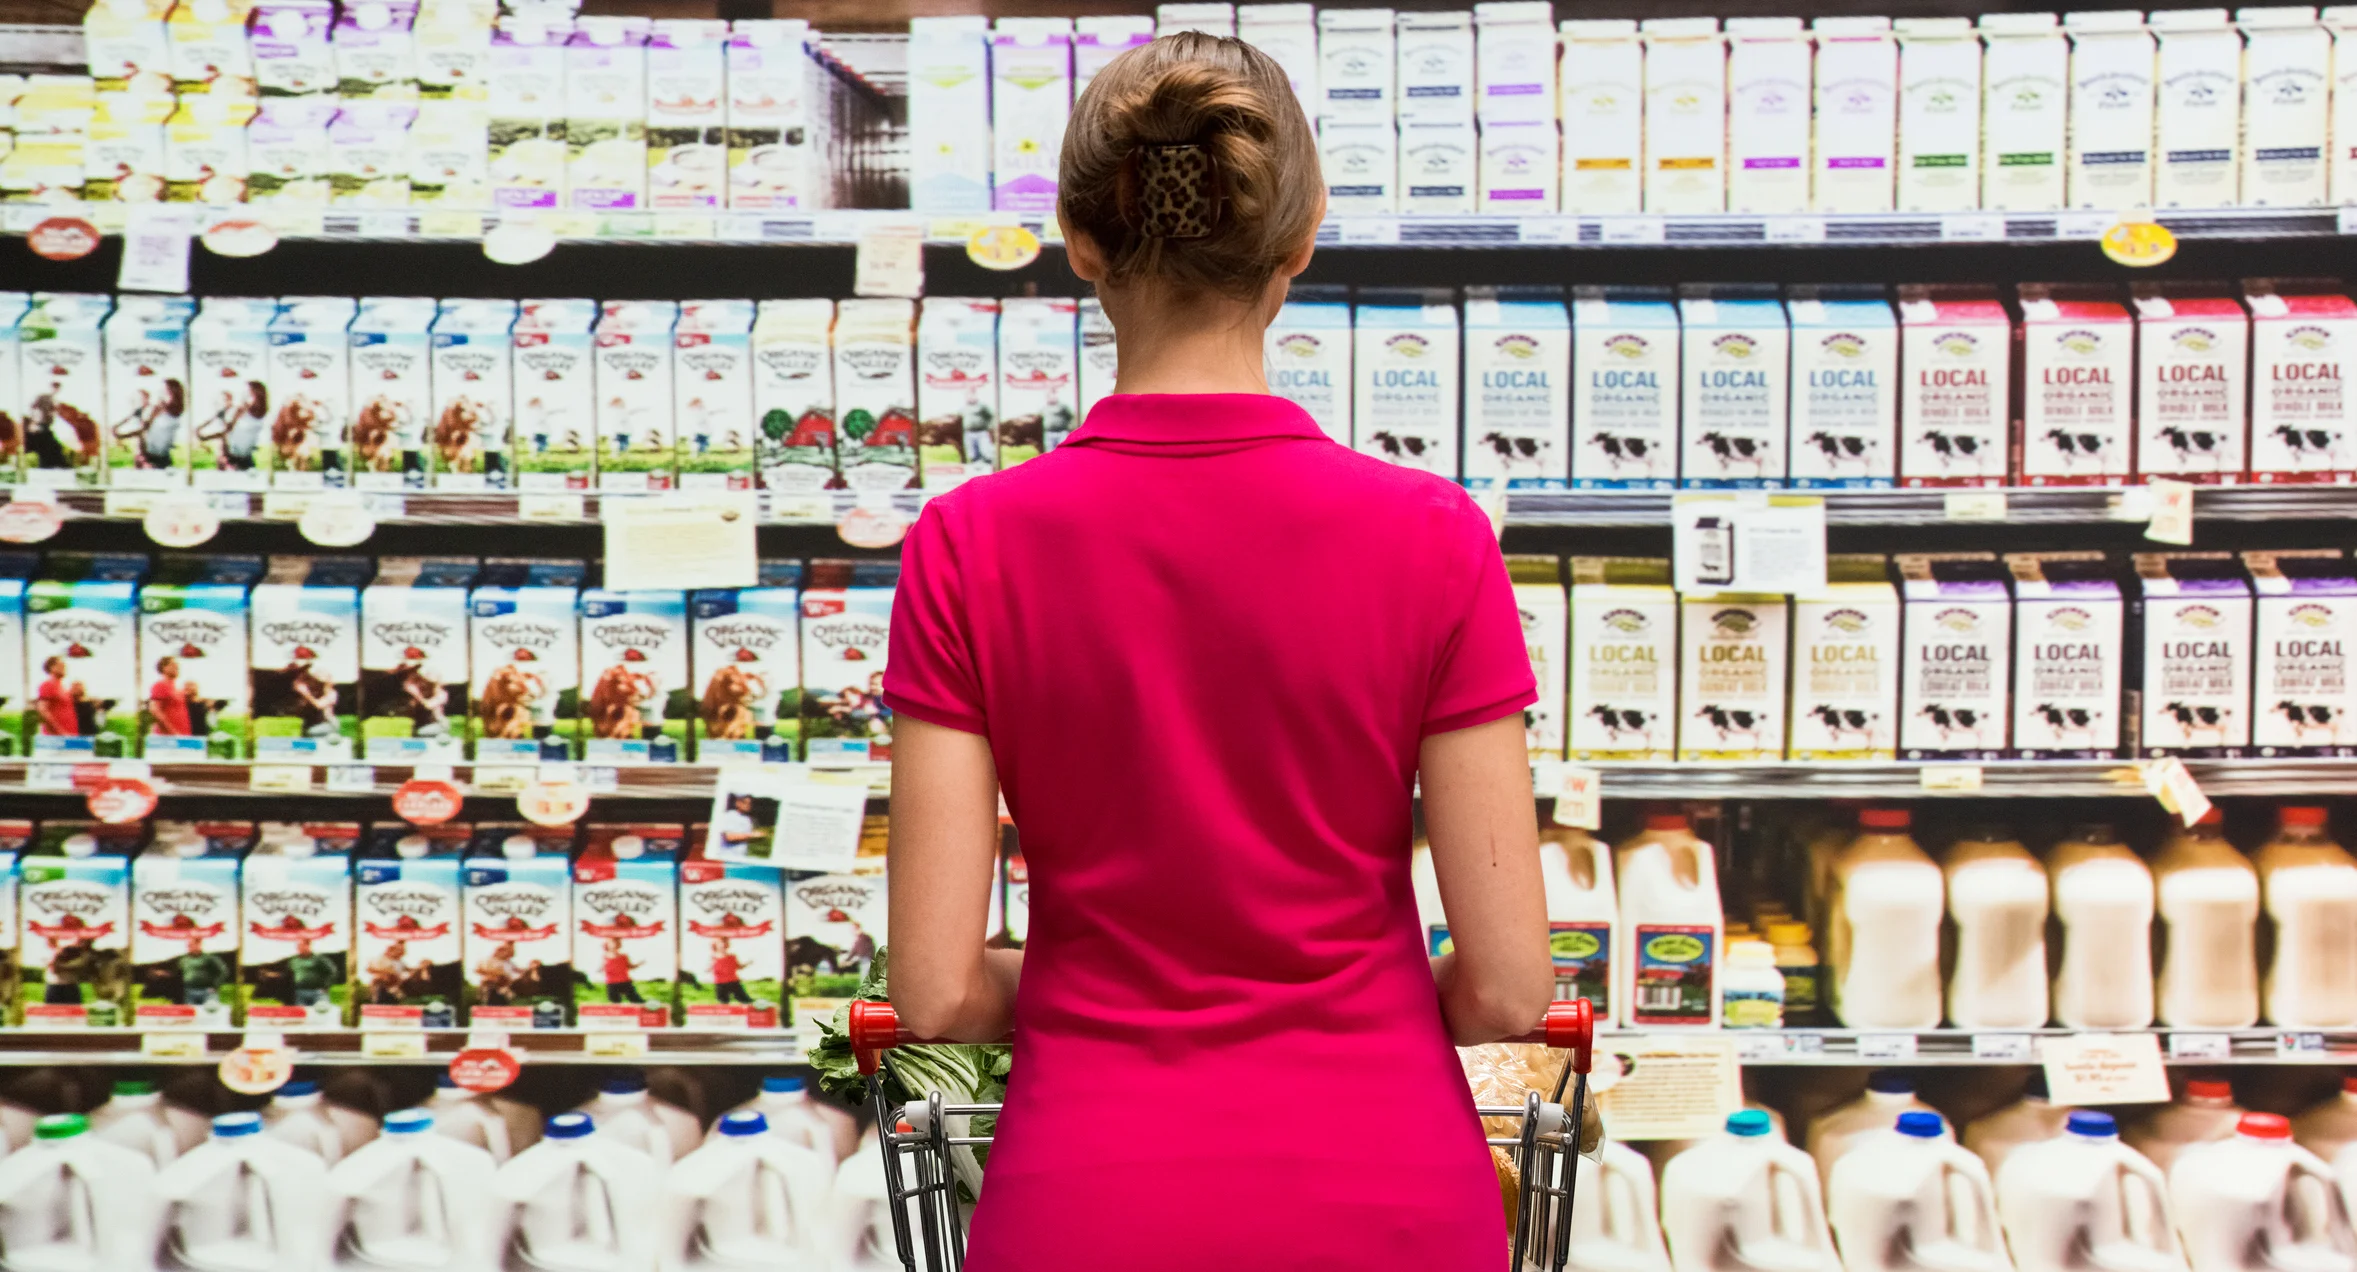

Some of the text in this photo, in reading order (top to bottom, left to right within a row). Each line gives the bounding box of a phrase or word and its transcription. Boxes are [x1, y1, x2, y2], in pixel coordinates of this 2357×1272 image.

[1267, 369, 1333, 389] LOCAL
[1372, 369, 1440, 389] LOCAL
[1482, 370, 1551, 390] LOCAL
[1591, 371, 1661, 389] LOCAL
[1700, 370, 1770, 389] LOCAL
[1808, 370, 1879, 389] LOCAL
[1920, 369, 1990, 387] LOCAL
[2043, 367, 2114, 385] LOCAL
[2157, 364, 2228, 383] LOCAL
[2271, 362, 2342, 381] LOCAL
[1481, 393, 1551, 404] ORGANIC
[1591, 393, 1660, 404] ORGANIC
[1700, 393, 1769, 403] ORGANIC
[1920, 391, 1989, 402] ORGANIC
[2043, 390, 2113, 401] ORGANIC
[2157, 387, 2227, 399] ORGANIC
[2271, 385, 2341, 397] ORGANIC
[37, 619, 119, 638] ORGANIC
[49, 628, 108, 645] VALLEY
[149, 619, 231, 638] ORGANIC
[161, 628, 219, 645] VALLEY
[261, 621, 342, 640] ORGANIC
[371, 622, 452, 640] ORGANIC
[482, 622, 563, 641] ORGANIC
[592, 623, 672, 641] ORGANIC
[704, 623, 786, 642] ORGANIC
[272, 630, 332, 647] VALLEY
[383, 631, 441, 648] VALLEY
[493, 631, 553, 648] VALLEY
[603, 632, 661, 649] VALLEY
[716, 632, 774, 649] VALLEY
[823, 632, 880, 649] VALLEY
[1589, 644, 1658, 662] LOCAL
[1699, 644, 1767, 662] LOCAL
[1810, 644, 1879, 662] LOCAL
[1921, 643, 1991, 662] LOCAL
[2034, 643, 2104, 661] LOCAL
[2163, 641, 2233, 660] LOCAL
[2275, 640, 2345, 658] LOCAL
[1921, 666, 1990, 677] ORGANIC
[2034, 664, 2103, 675] ORGANIC
[2163, 663, 2233, 673] ORGANIC
[2274, 661, 2345, 672] ORGANIC
[30, 890, 111, 907] ORGANIC
[141, 890, 222, 907] ORGANIC
[251, 891, 332, 908] ORGANIC
[367, 891, 448, 908] ORGANIC
[475, 892, 557, 910] ORGANIC
[584, 888, 663, 906] ORGANIC
[691, 888, 770, 906] ORGANIC
[796, 883, 875, 902] ORGANIC
[807, 892, 866, 908] VALLEY
[40, 899, 104, 915] VALLEY
[152, 899, 214, 915] VALLEY
[262, 900, 322, 916] VALLEY
[377, 900, 438, 916] VALLEY
[486, 901, 546, 917] VALLEY
[593, 897, 652, 913] VALLEY
[701, 897, 760, 913] VALLEY
